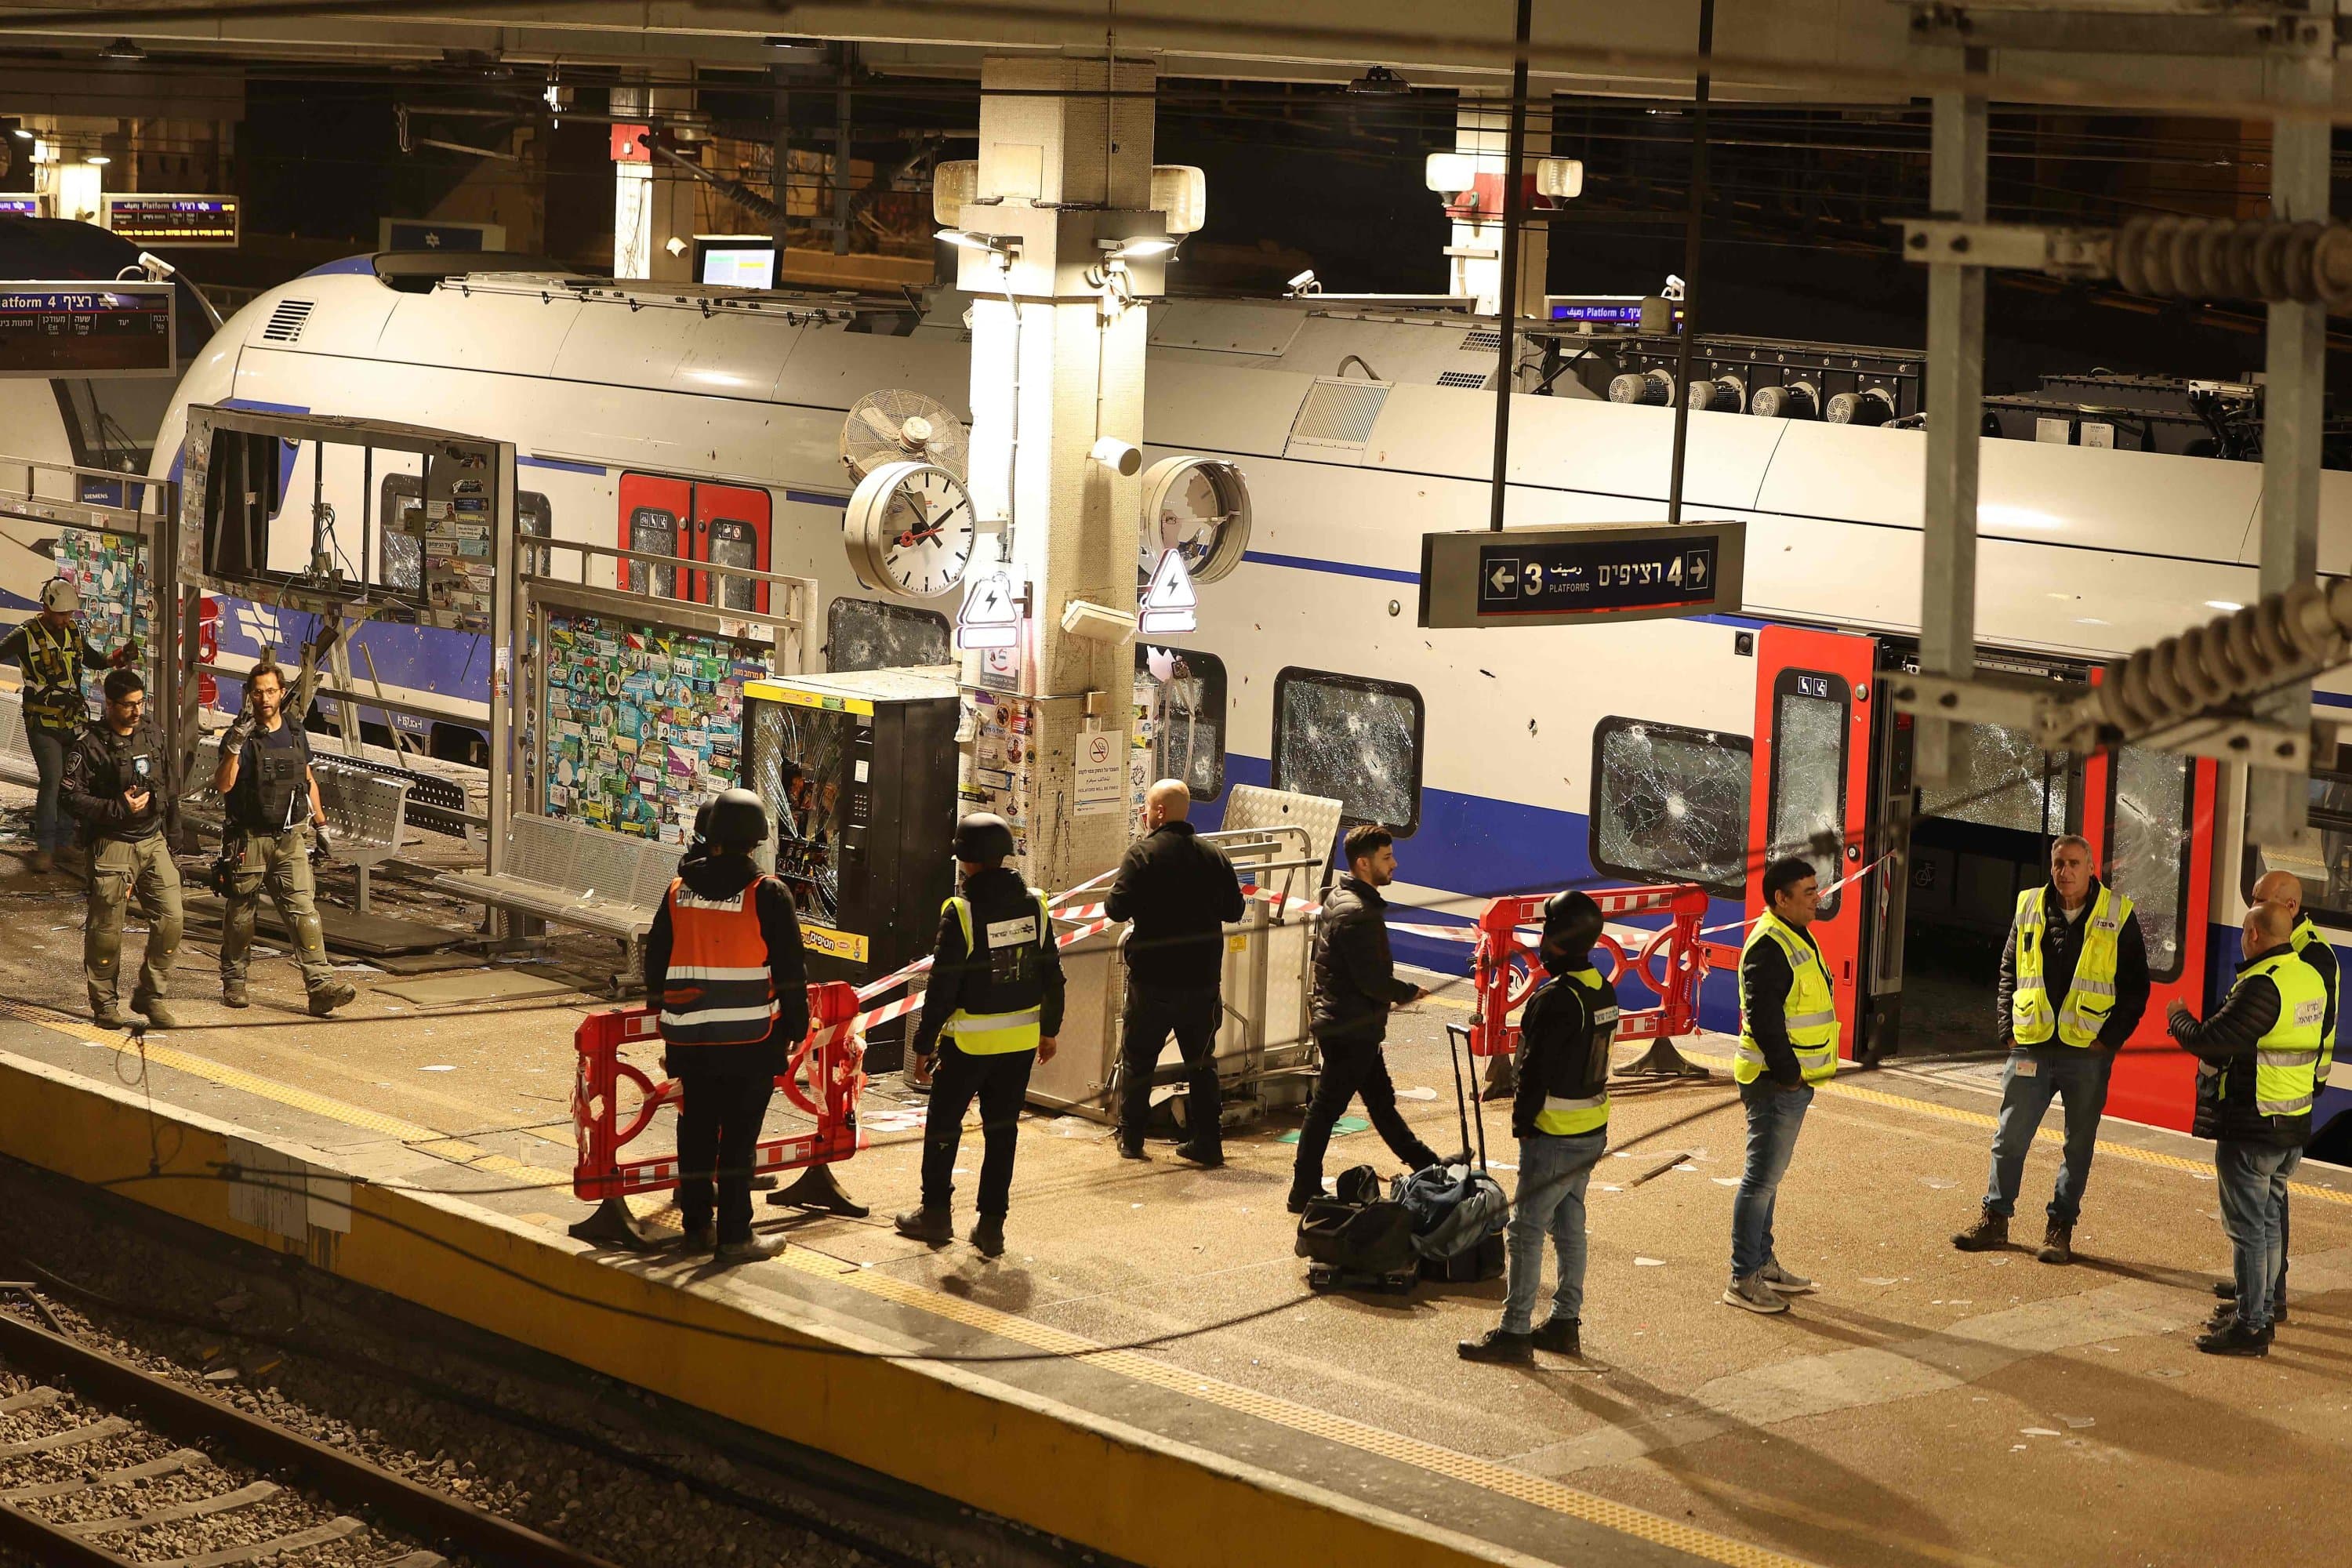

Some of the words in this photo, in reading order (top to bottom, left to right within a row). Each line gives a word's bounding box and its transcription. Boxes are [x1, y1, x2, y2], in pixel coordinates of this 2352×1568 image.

[0, 296, 42, 308] atform
[48, 296, 56, 308] 4
[63, 296, 92, 311] רציף
[1587, 307, 1617, 317] Platform
[1620, 307, 1625, 318] 6
[1628, 307, 1642, 319] ציף
[1550, 563, 1582, 575] رصيف
[1598, 562, 1661, 586] רציפים
[1667, 556, 1682, 587] 4
[1524, 563, 1542, 595] 3
[1549, 582, 1590, 593] PLATFORMS
[811, 932, 834, 950] חטיפים
